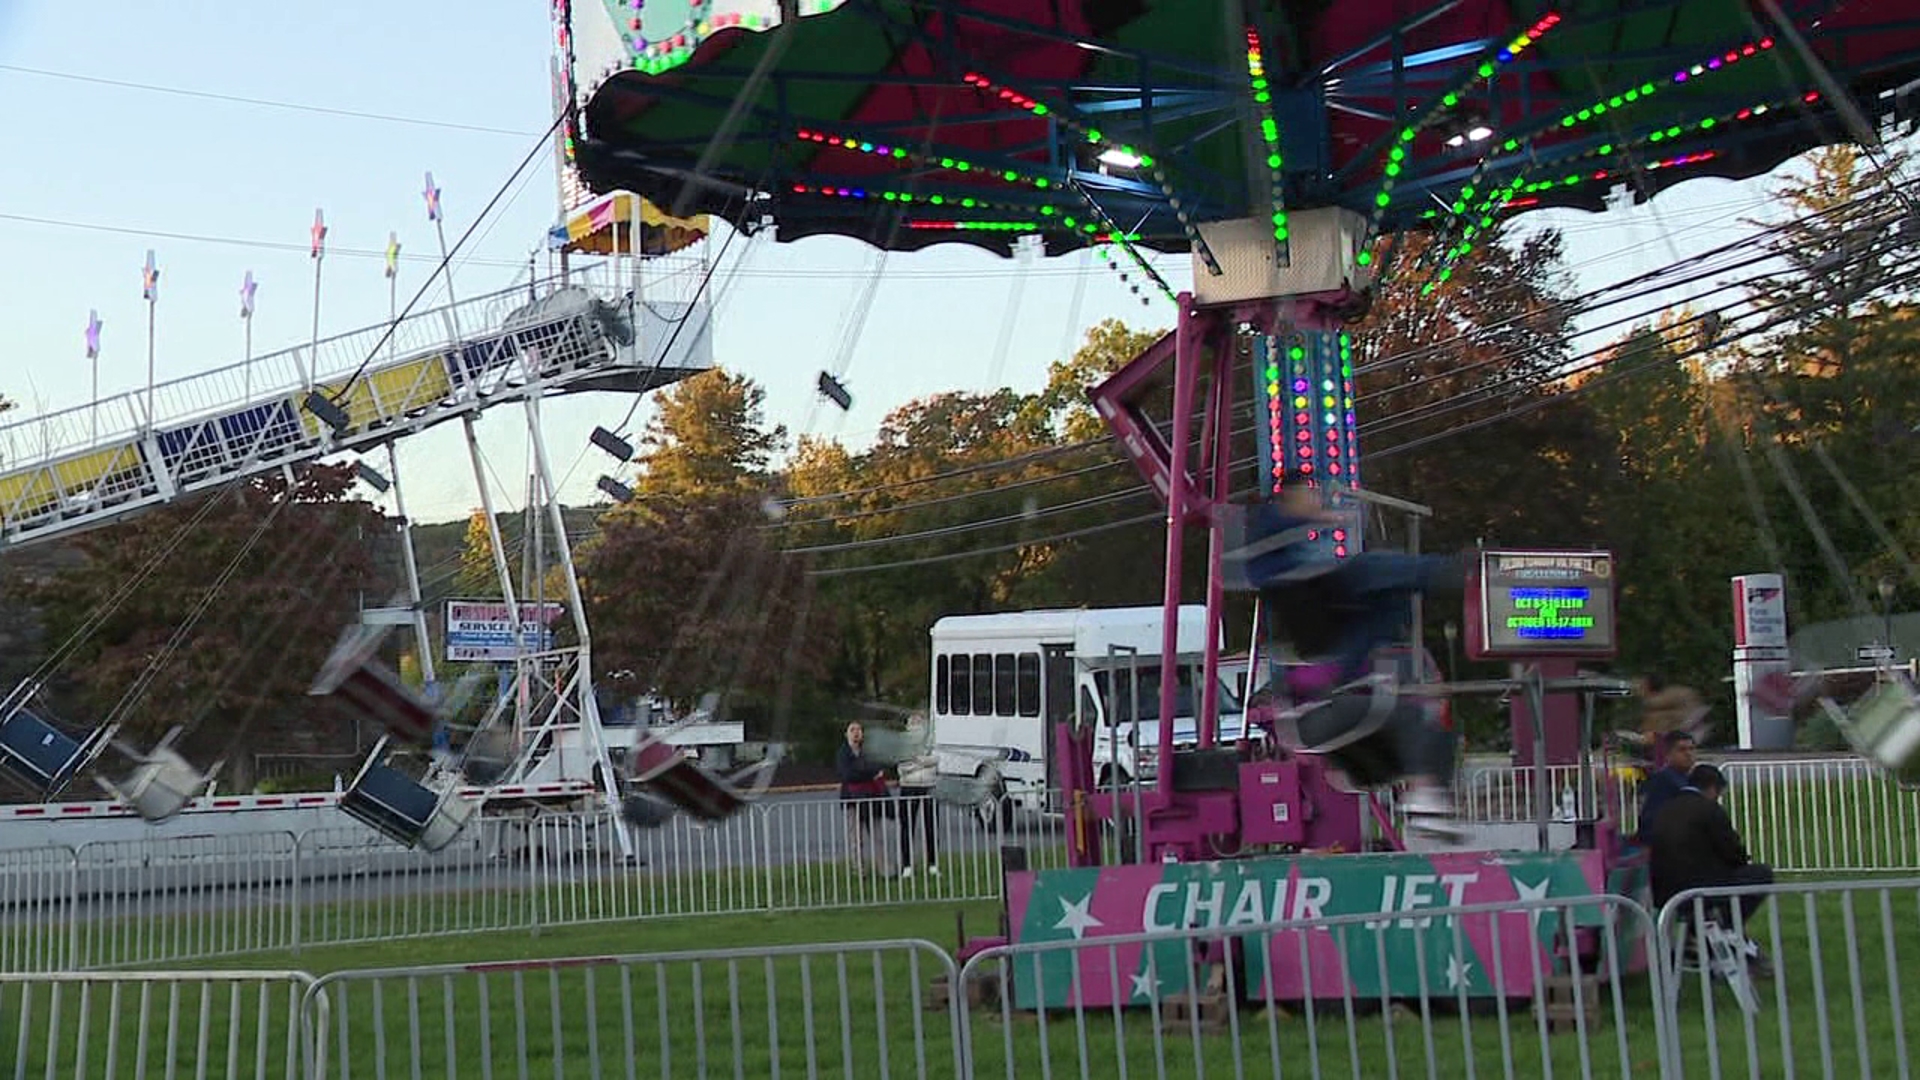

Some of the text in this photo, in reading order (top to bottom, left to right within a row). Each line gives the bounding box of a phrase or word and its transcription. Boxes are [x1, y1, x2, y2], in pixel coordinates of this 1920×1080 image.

[459, 622, 505, 632] SERVICE
[1142, 871, 1479, 933] CHAIR JET
